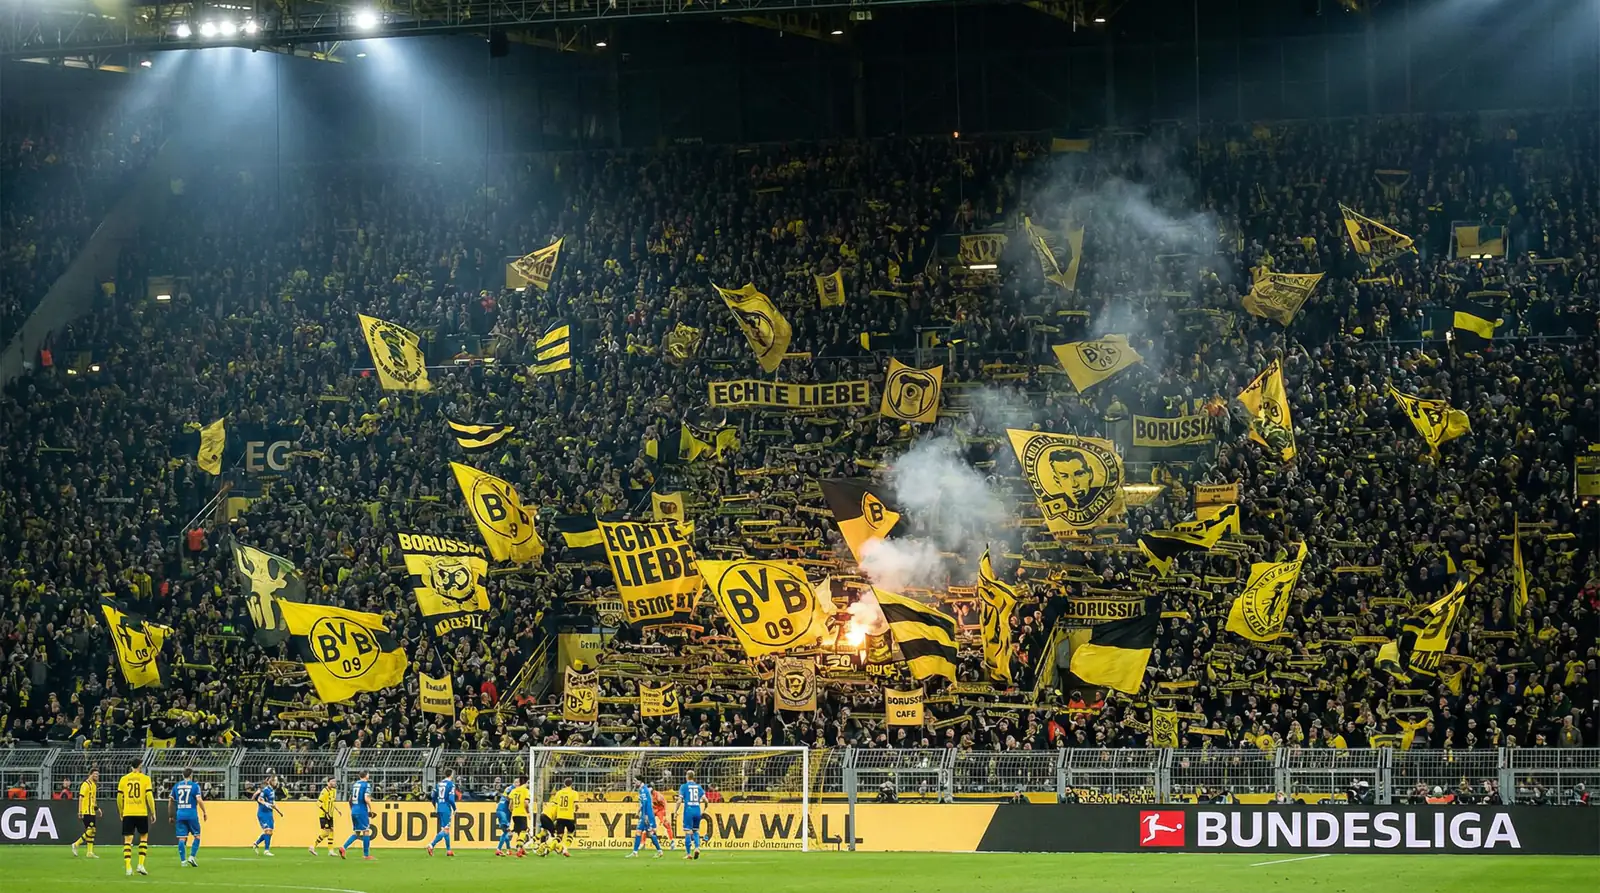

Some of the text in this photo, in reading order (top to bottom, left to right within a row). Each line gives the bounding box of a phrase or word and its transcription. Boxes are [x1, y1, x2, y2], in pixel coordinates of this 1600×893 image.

[714, 382, 866, 406] ECHTE LIEBE
[1136, 417, 1215, 441] BORUSSIA
[602, 522, 684, 552] ECHTE
[612, 544, 699, 587] LIEBE
[727, 568, 808, 625] BVB
[1066, 602, 1141, 617] BORUSSIA
[765, 617, 795, 640] 09
[317, 622, 373, 663] BVB
[342, 657, 362, 673] 09
[896, 710, 917, 718] CAFE
[127, 782, 140, 798] 28
[178, 789, 192, 804] 27
[1, 806, 59, 839] GA
[760, 813, 864, 843] WALL
[1197, 811, 1522, 848] BUNDESLIGA
